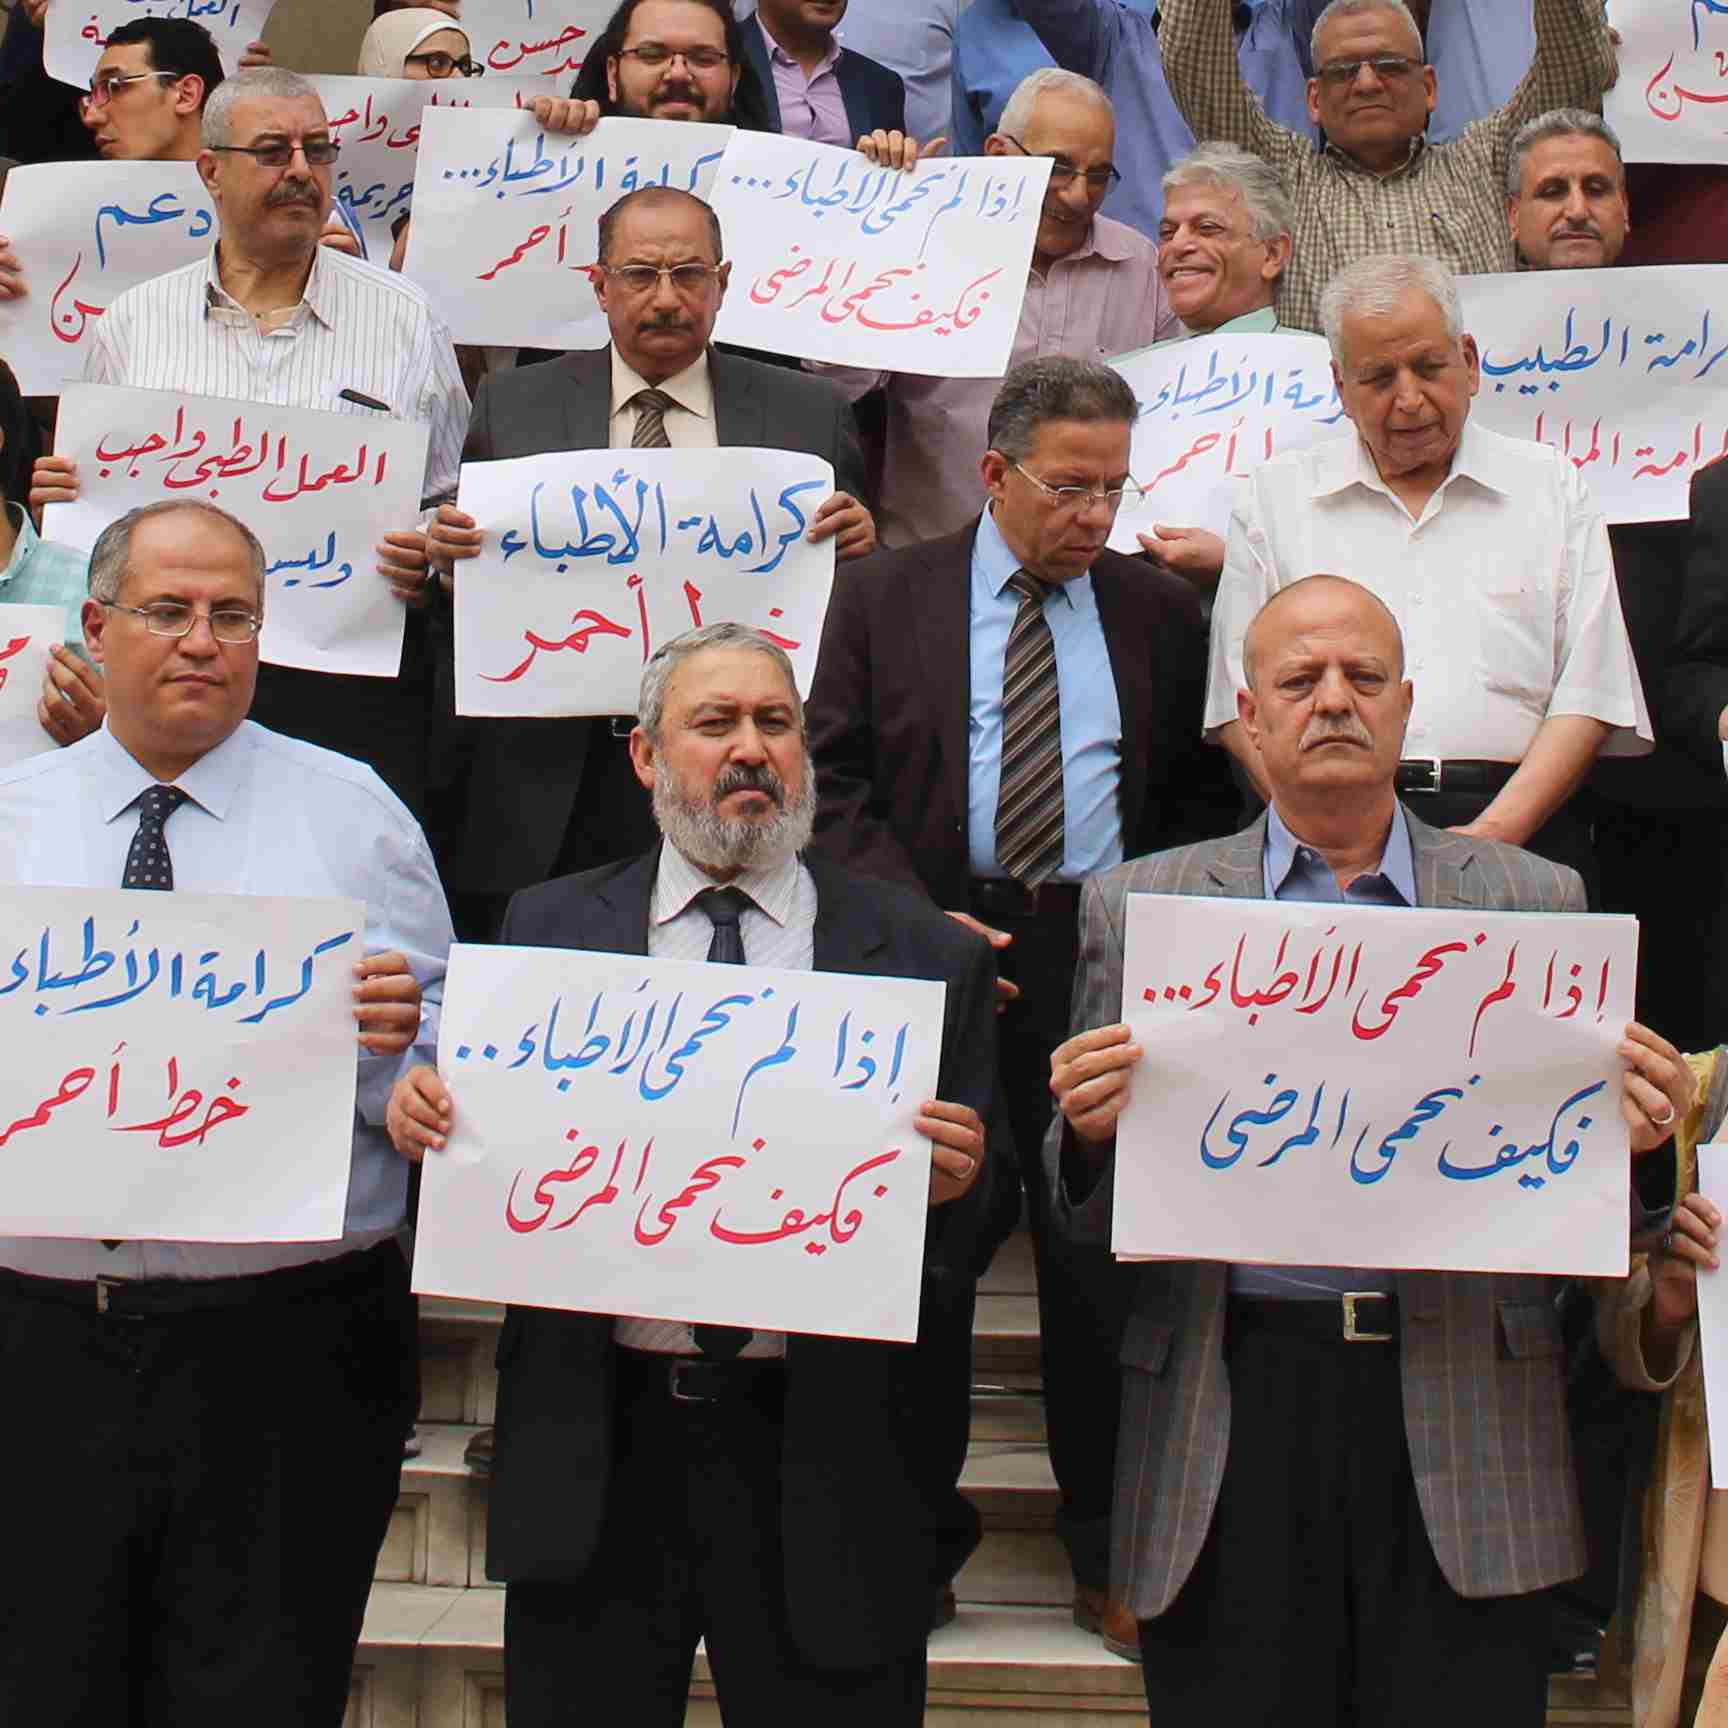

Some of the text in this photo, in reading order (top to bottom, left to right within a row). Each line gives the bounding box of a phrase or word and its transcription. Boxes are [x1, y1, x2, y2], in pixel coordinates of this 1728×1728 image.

[918, 169, 970, 260] لم
[856, 268, 1004, 335] فكيف
[1481, 307, 1629, 392] الطبيب
[96, 406, 206, 477] واجب
[263, 445, 385, 502] العمل
[500, 467, 826, 573] كرامة الأطباء
[192, 932, 353, 1022] كرامة
[1470, 940, 1519, 1058] لم
[1543, 950, 1610, 1024] إذا
[108, 1057, 251, 1147] خط
[732, 1001, 800, 1140] لم
[834, 1009, 909, 1103] إذا
[1200, 1073, 1350, 1170] المرضى
[1438, 1080, 1606, 1189] فكيف
[505, 1129, 655, 1234] المرضى
[710, 1149, 901, 1256] فكيف
